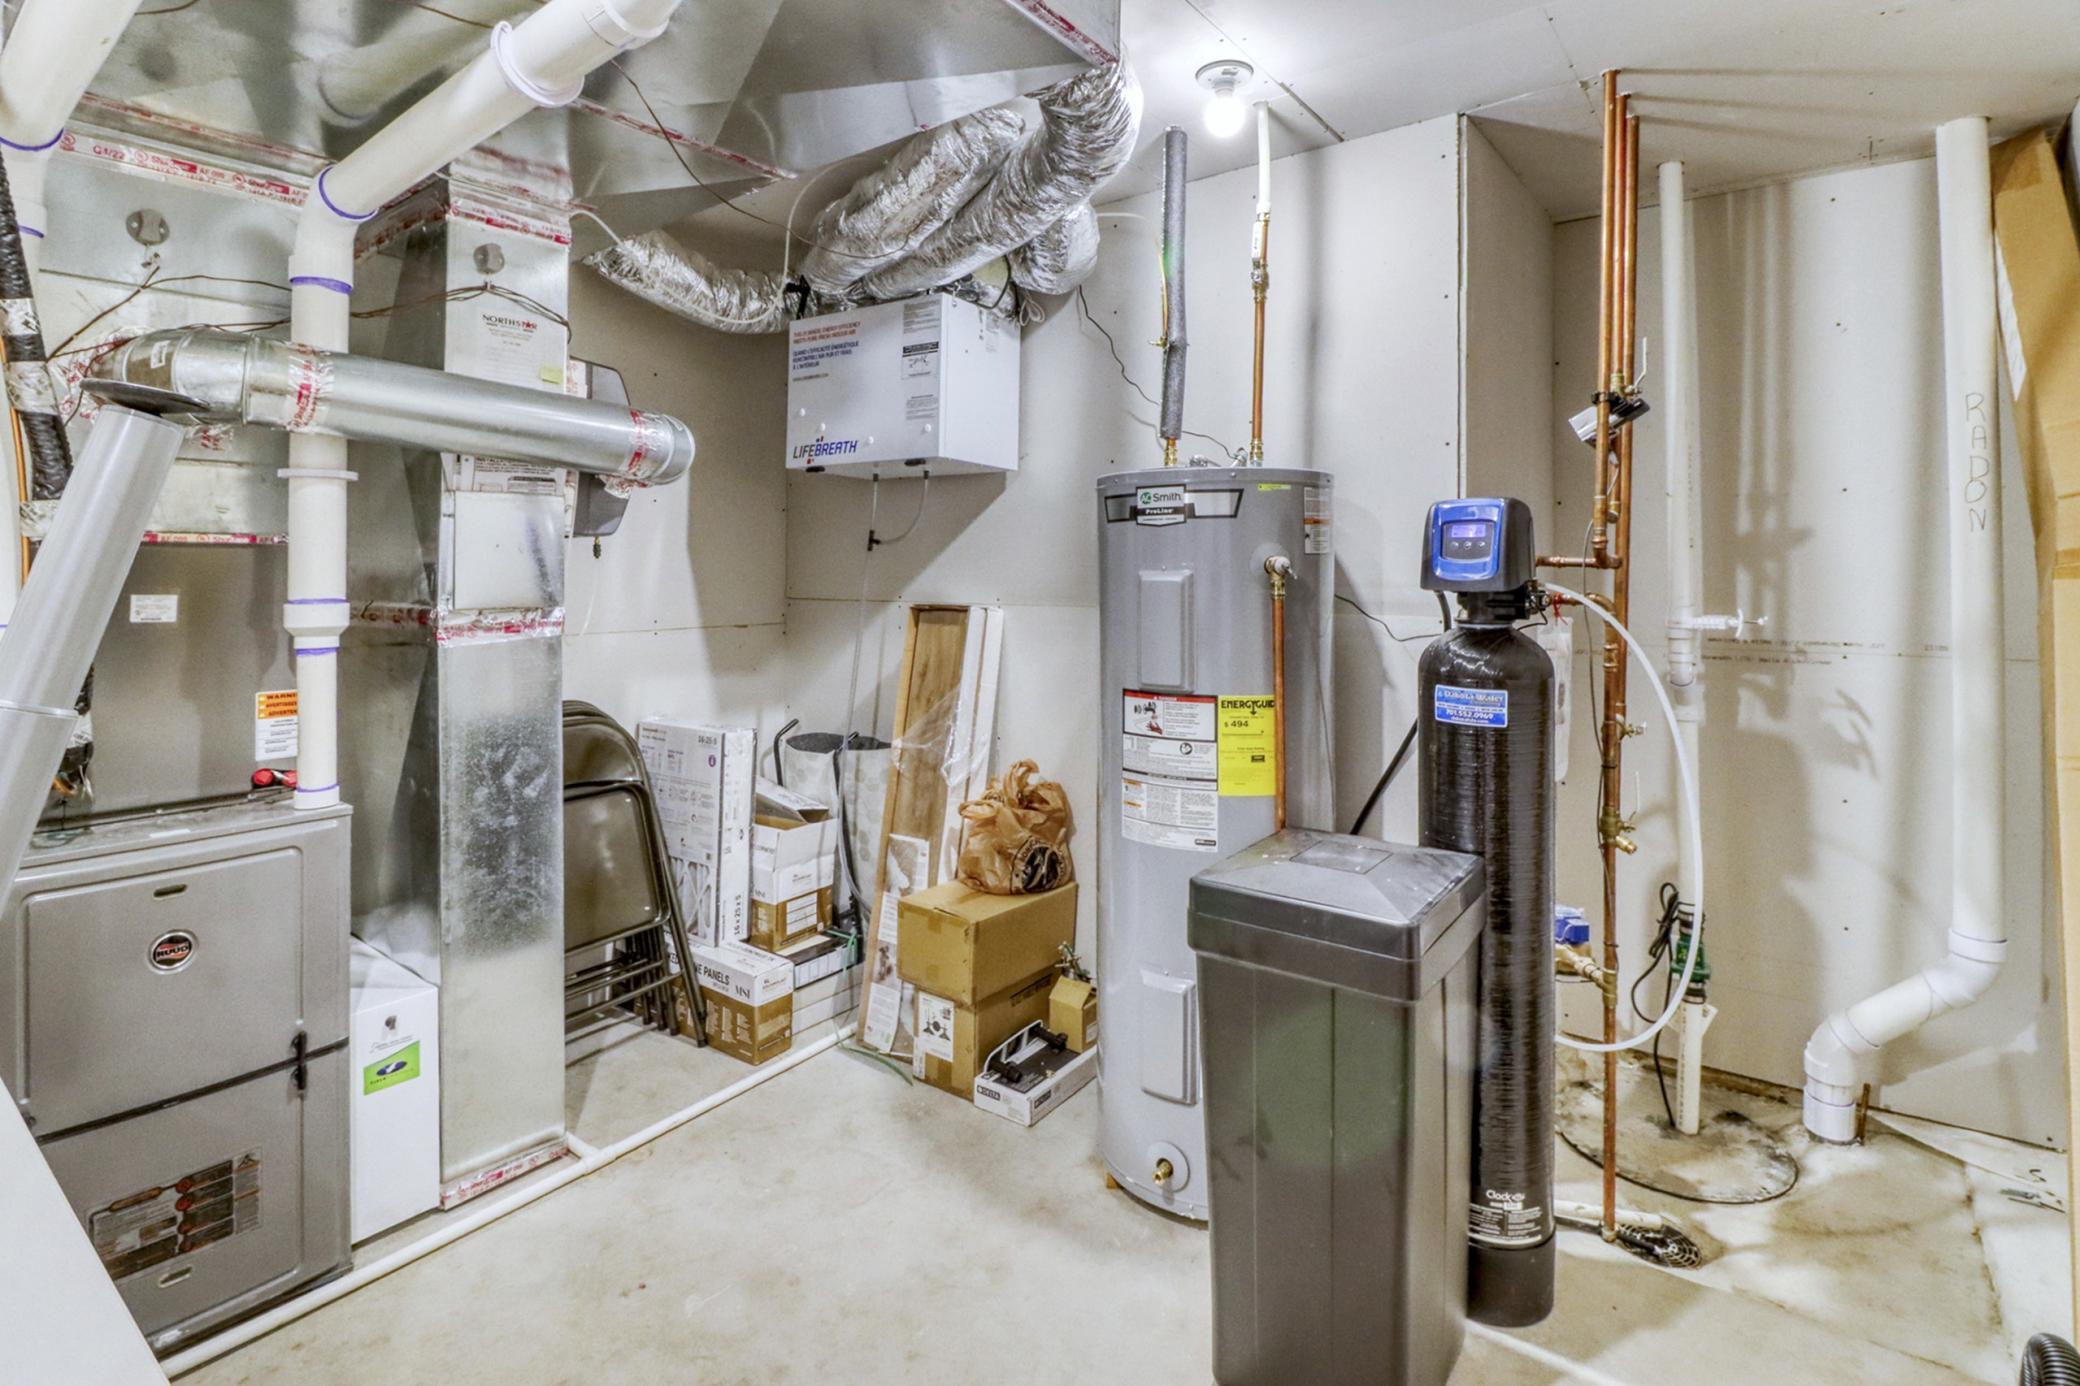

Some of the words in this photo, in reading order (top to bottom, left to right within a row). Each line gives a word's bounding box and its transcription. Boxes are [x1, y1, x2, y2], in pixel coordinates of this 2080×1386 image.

[793, 440, 858, 459] LIFEBREATH
[1965, 392, 1990, 533] RADON
[1153, 492, 1181, 502] Smith
[1230, 720, 1249, 728] 494
[703, 966, 730, 985] PANELS
